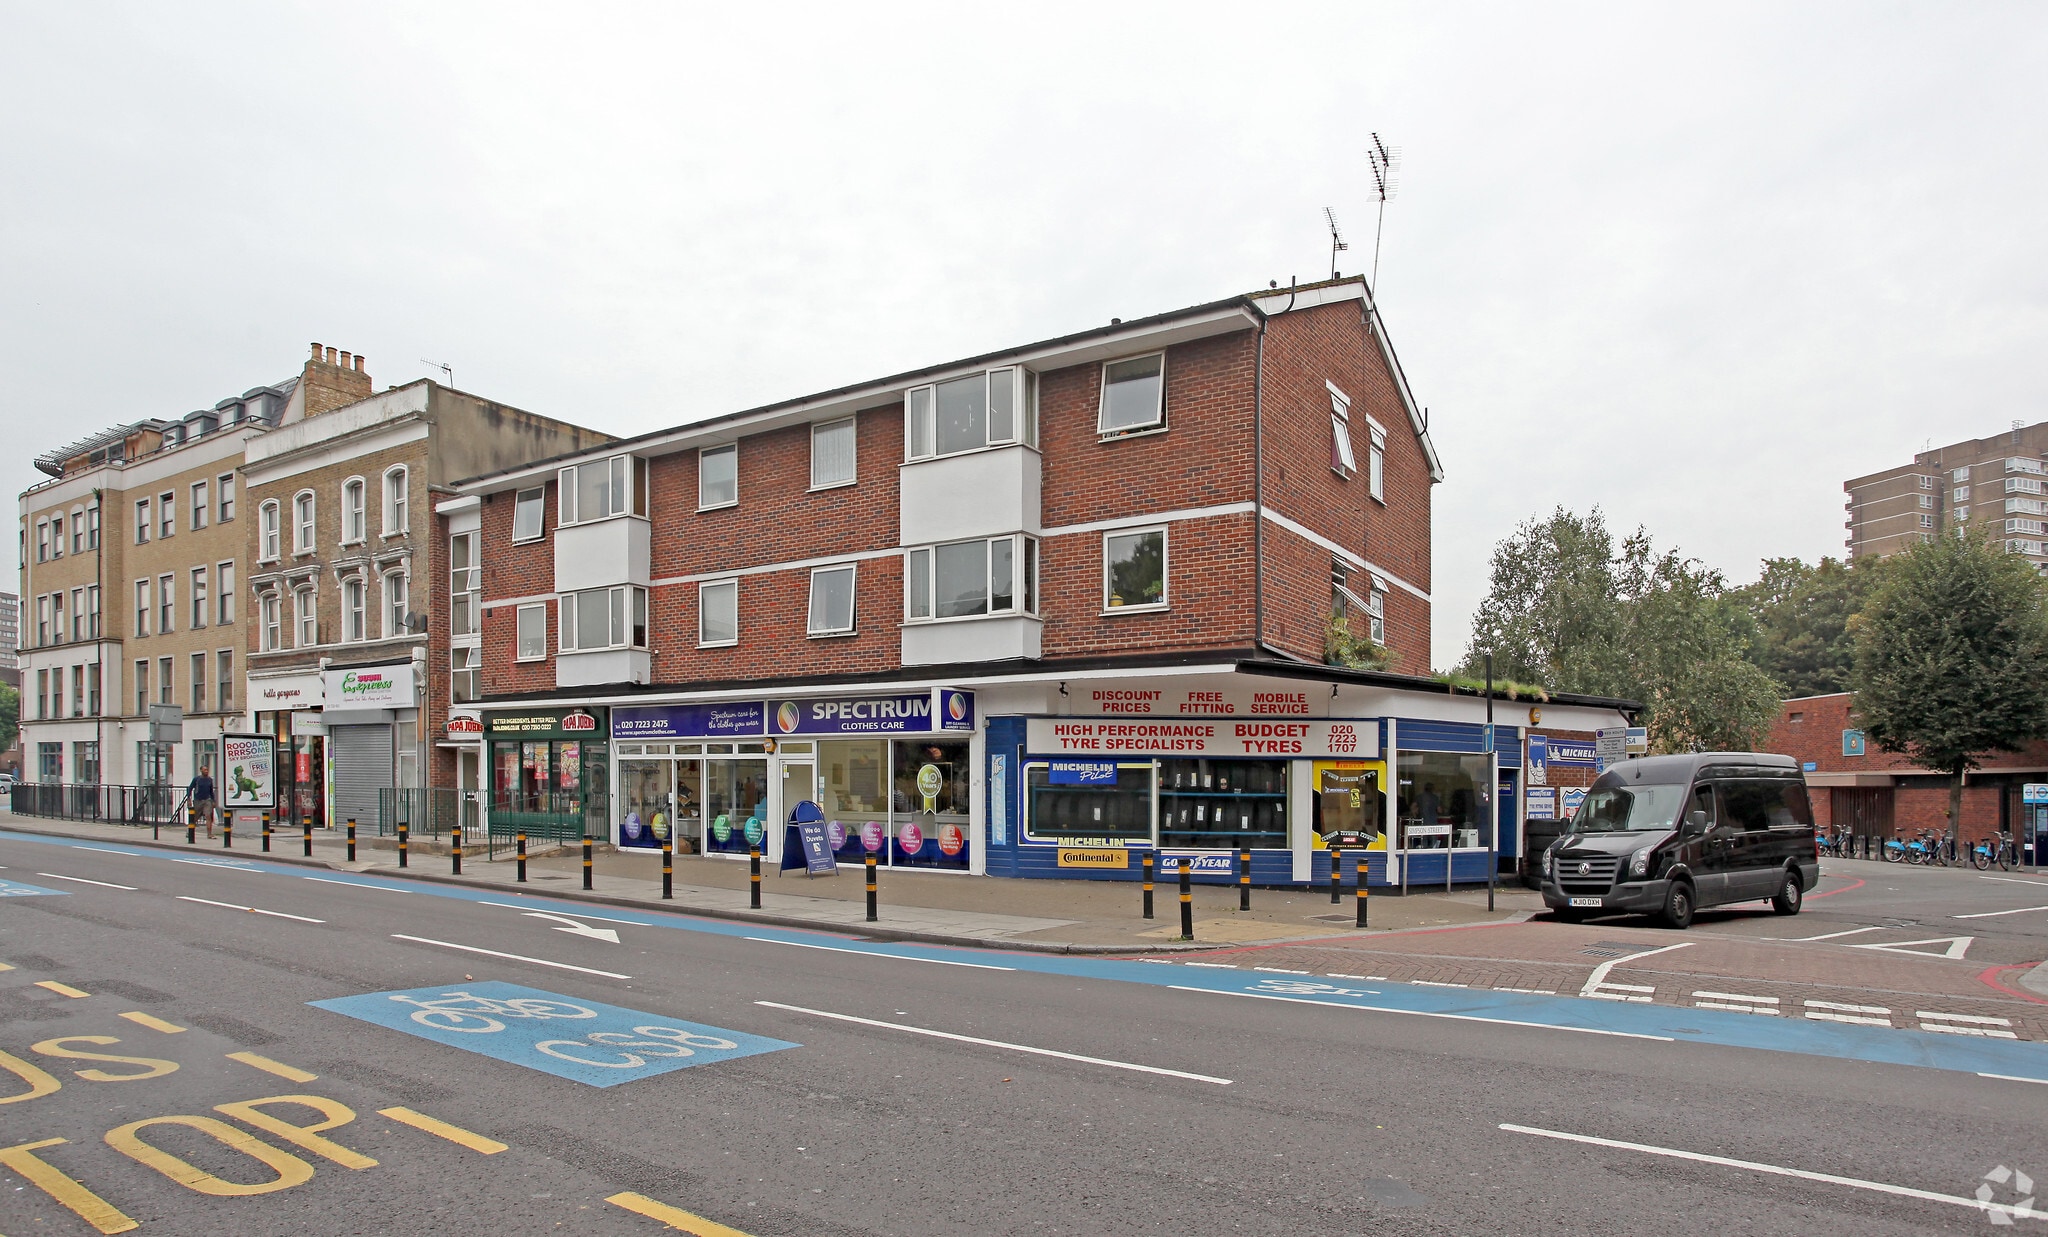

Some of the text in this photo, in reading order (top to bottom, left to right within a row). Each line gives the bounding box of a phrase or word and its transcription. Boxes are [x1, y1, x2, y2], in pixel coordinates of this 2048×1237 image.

[342, 672, 392, 694] Express
[357, 674, 382, 682] SUSHI
[264, 689, 300, 700] hello gorgeous
[1092, 691, 1306, 703] DISCOUNT FREE MOBILE
[812, 699, 932, 720] SPECTRUM
[1103, 703, 1309, 714] PRICES FITTING SERVICE
[711, 711, 736, 721] Spectrum
[749, 708, 759, 717] for
[448, 720, 463, 732] PAPA
[563, 714, 576, 730] PAPA
[621, 721, 633, 729] 020
[634, 720, 651, 729] 7223
[652, 719, 668, 728] 2475
[708, 721, 716, 729] the
[717, 720, 734, 729] clothes
[734, 723, 745, 731] you
[841, 721, 905, 731] CLOTHES CARE
[1055, 725, 1214, 737] HIGH PERFORMANCE
[1235, 724, 1310, 737] BUDGET
[1331, 725, 1353, 734] 020
[1060, 738, 1205, 750] TYRE SPECIALISTS
[1327, 734, 1357, 743] 7223
[226, 740, 269, 750] ROOOAAR
[1242, 740, 1302, 753] TYRES
[1327, 744, 1357, 753] 1707
[228, 747, 270, 757] RRRSOME
[1561, 748, 1597, 758] MICHELI
[1052, 763, 1113, 772] MICHELIN
[922, 773, 938, 783] 40
[1080, 771, 1113, 781] Pilot
[1057, 837, 1125, 847] MICHELIN
[1063, 852, 1114, 863] Continental
[1162, 856, 1231, 869] GODYEAR
[535, 1026, 738, 1069] CS8
